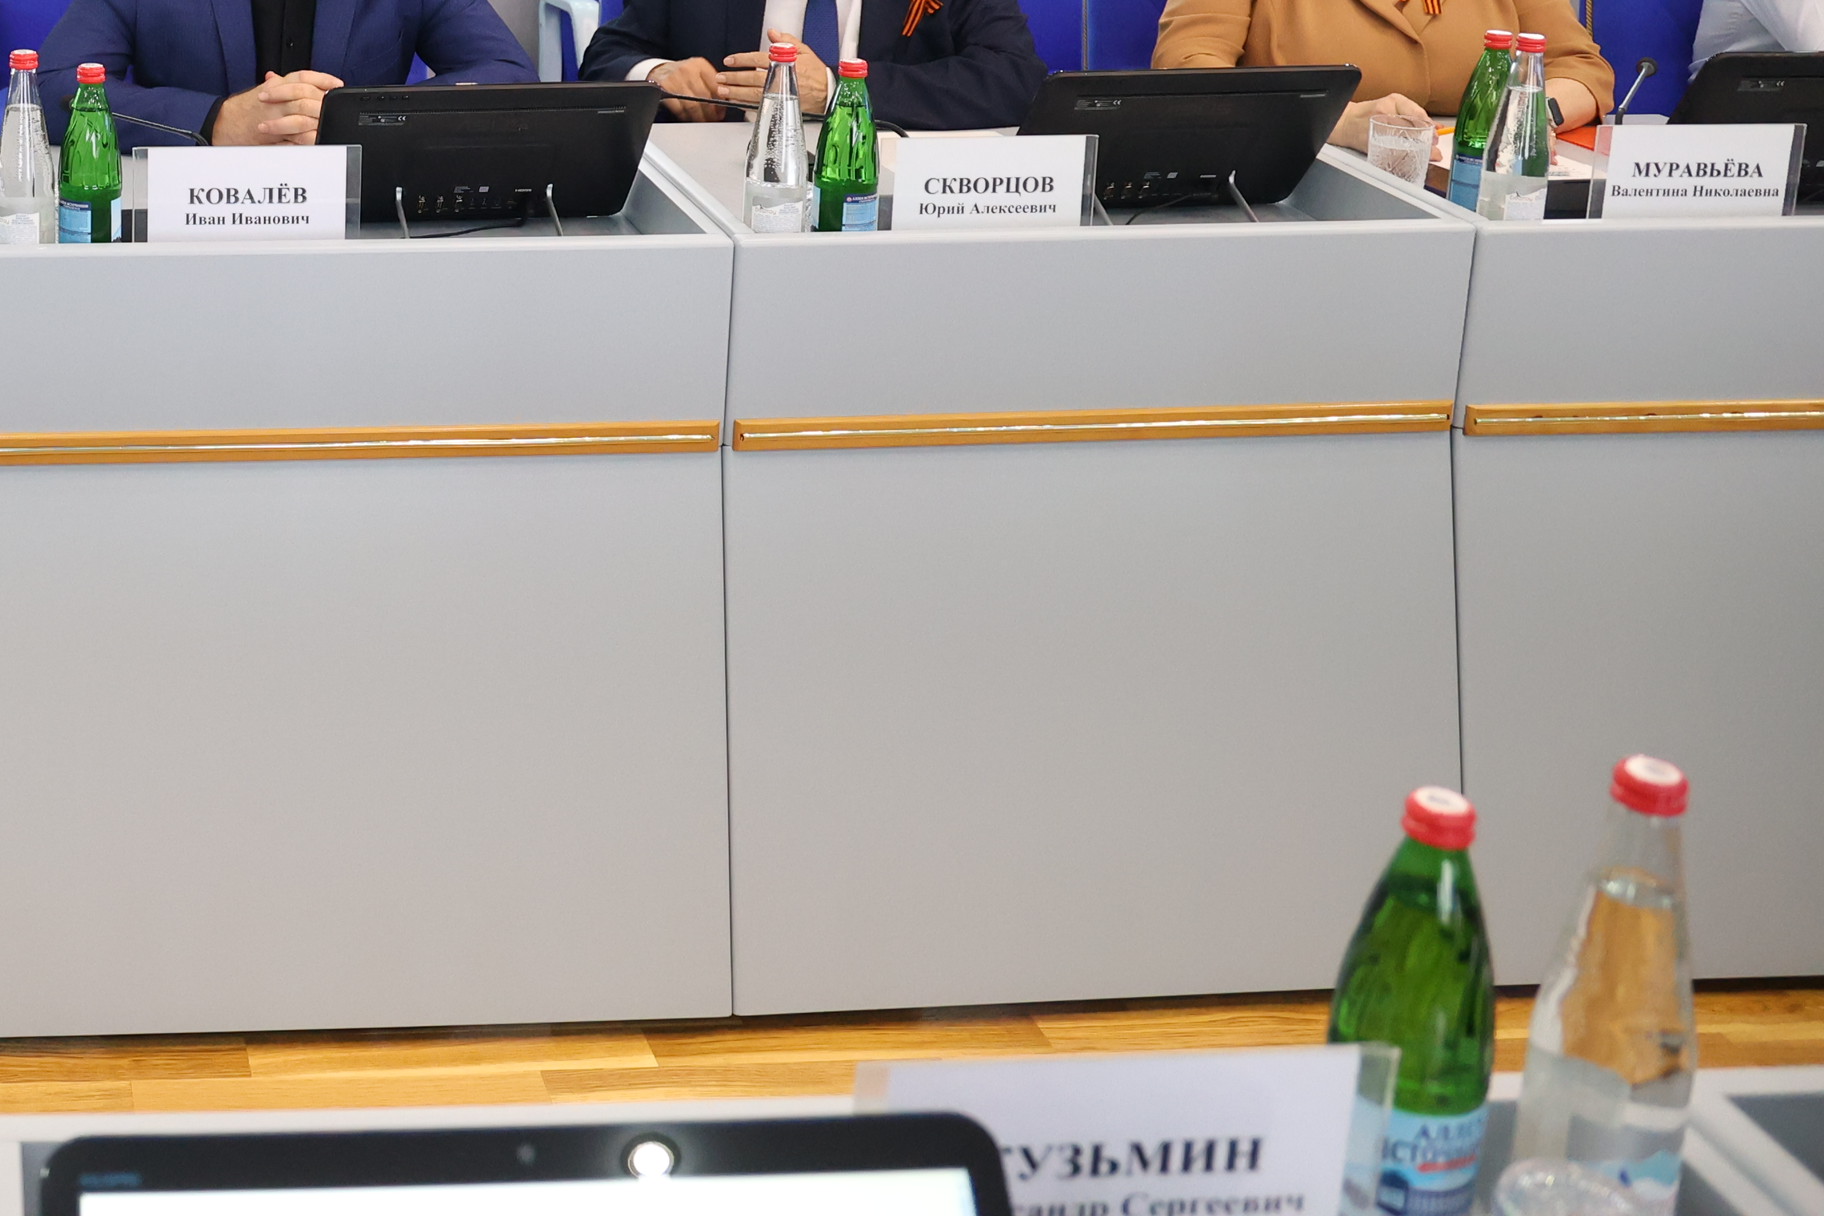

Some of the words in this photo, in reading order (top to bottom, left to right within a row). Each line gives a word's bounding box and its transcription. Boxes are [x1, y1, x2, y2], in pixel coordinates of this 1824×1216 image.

[1632, 158, 1764, 178] МУРАВЬЁВА
[188, 183, 308, 205] КОВАЛЁВ
[924, 176, 1055, 197] СКВОРЦОВ
[1611, 185, 1688, 197] Валентина
[1692, 185, 1779, 197] Николаевна
[185, 212, 226, 225] Иван
[232, 212, 309, 225] Иванович
[919, 202, 965, 218] Юрий
[969, 203, 1056, 215] Алексеевич
[999, 1136, 1264, 1181] УЗЬМИН
